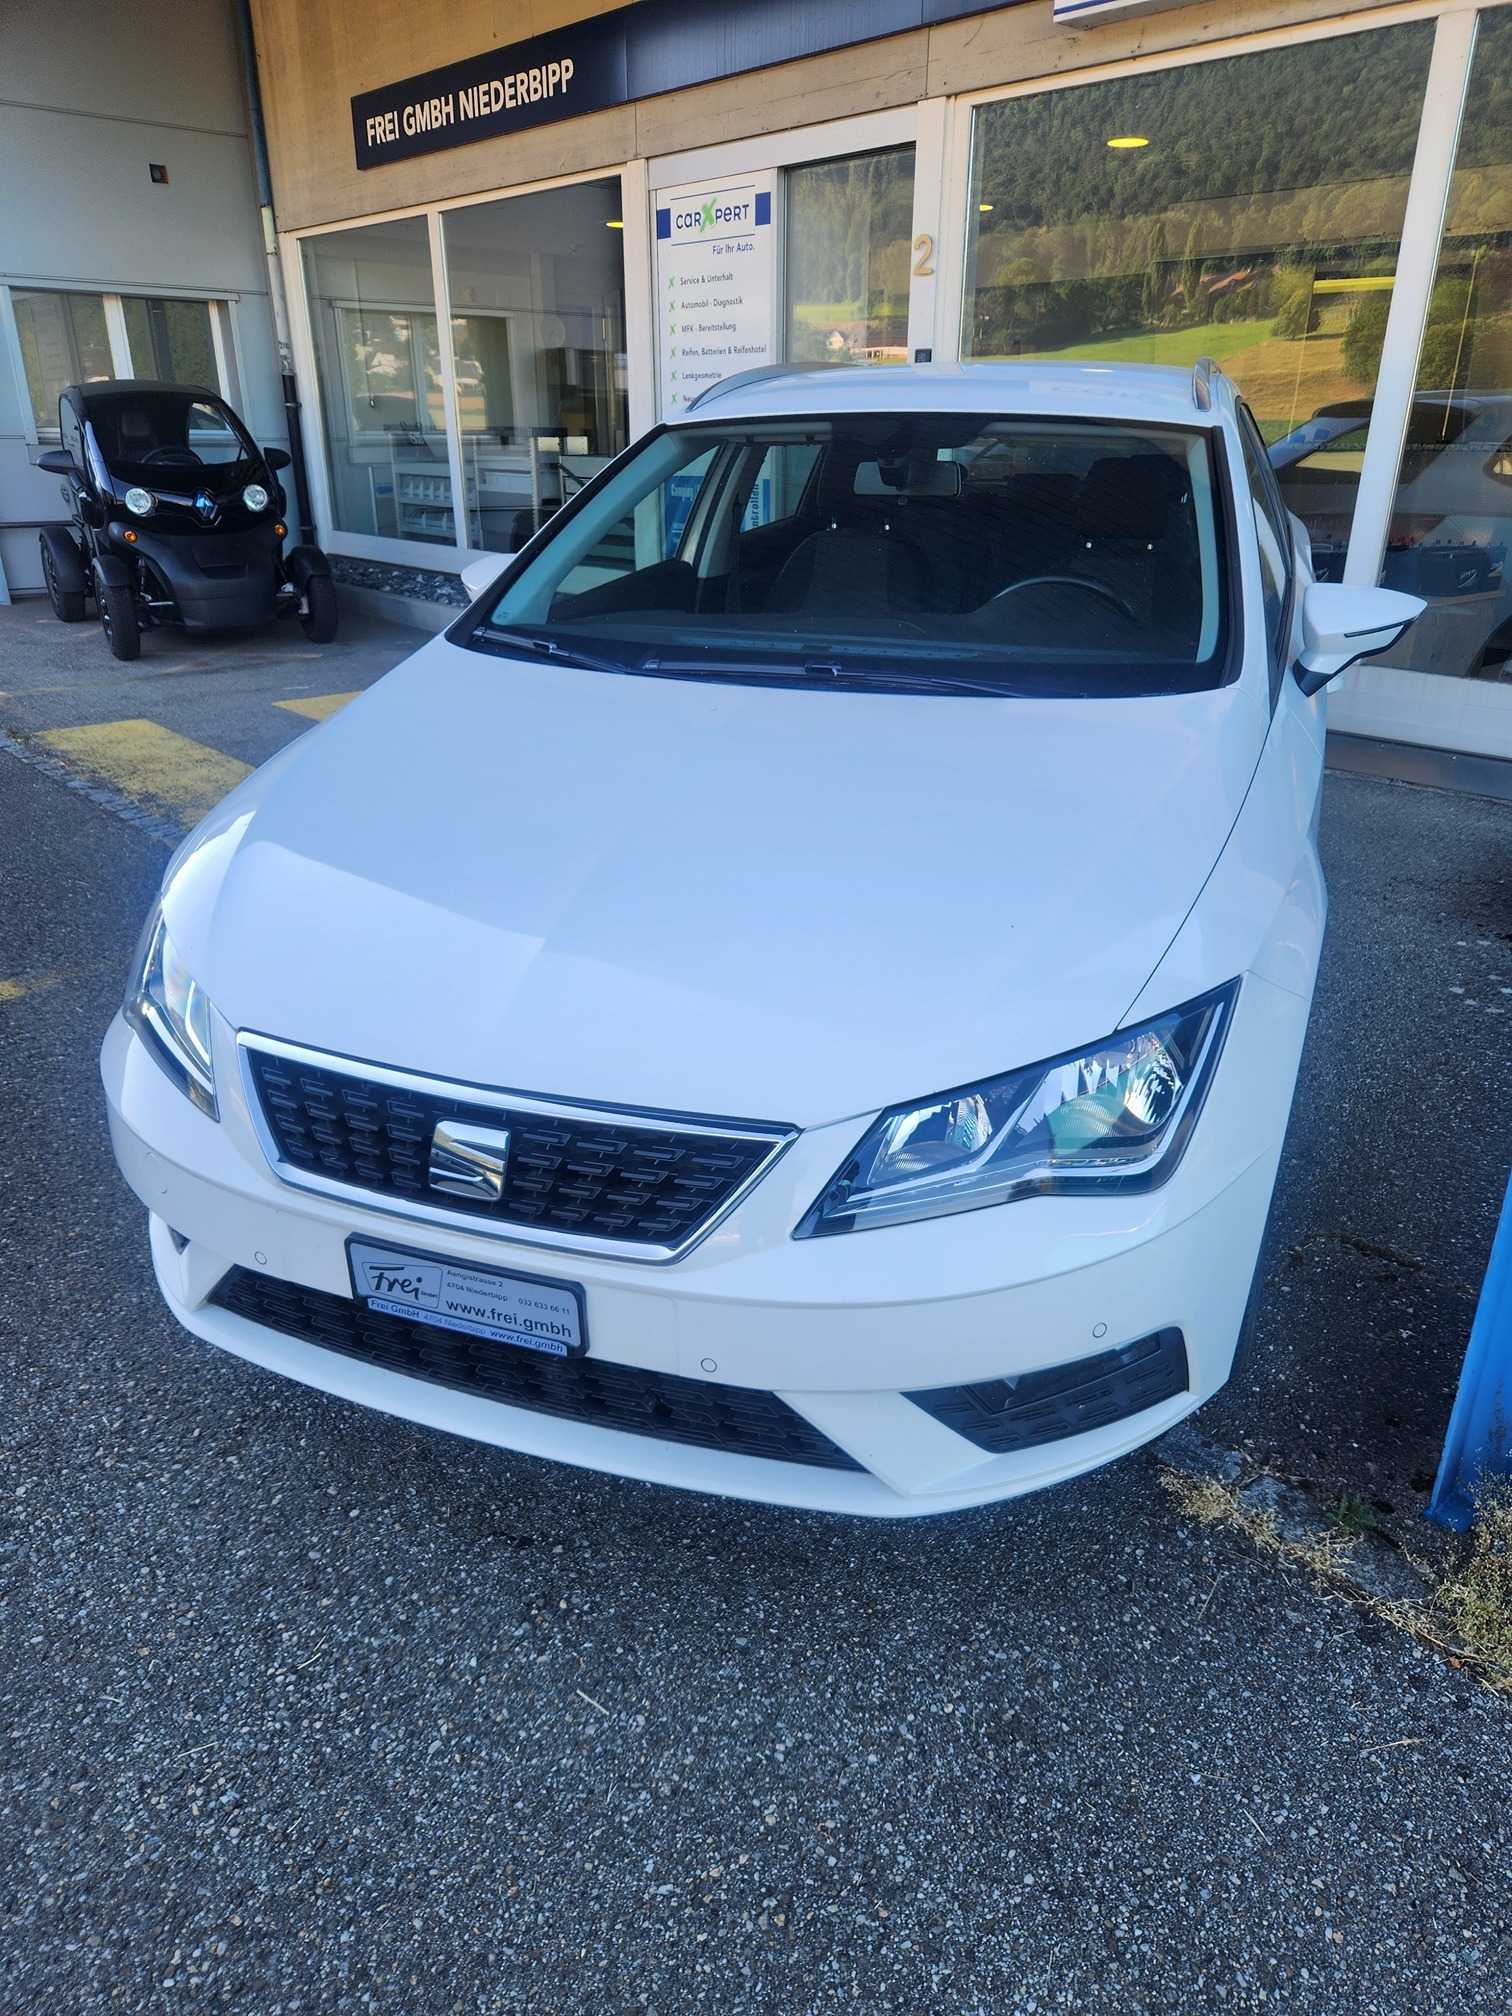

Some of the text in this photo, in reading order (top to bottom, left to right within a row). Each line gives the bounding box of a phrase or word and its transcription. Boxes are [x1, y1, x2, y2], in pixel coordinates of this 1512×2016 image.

[366, 58, 575, 147] FREI GMBH NIEDERBIPP
[712, 242, 756, 255] Für Ihr Auto.
[913, 233, 934, 275] 2
[680, 272, 734, 286] Service & Unterhalt
[681, 299, 709, 309] Automobil
[713, 296, 743, 308] Diagnostik
[681, 325, 694, 333] MFK
[698, 322, 737, 332] Bereitstellung
[682, 343, 767, 357] Reifen, Batterien & Reifenhotel
[682, 371, 722, 381] Lenkgeometrie
[369, 1265, 423, 1301] Frei
[447, 1269, 497, 1287] Aengistrasse
[446, 1282, 508, 1302] 4704 Niederbipp
[518, 1297, 532, 1307] 032
[534, 1301, 548, 1310] 633
[550, 1304, 560, 1313] 66
[371, 1299, 564, 1353] Frei GmbH 4704 Niederbipp www.frei.gmbh
[446, 1300, 572, 1338] www.frei.gmbh
